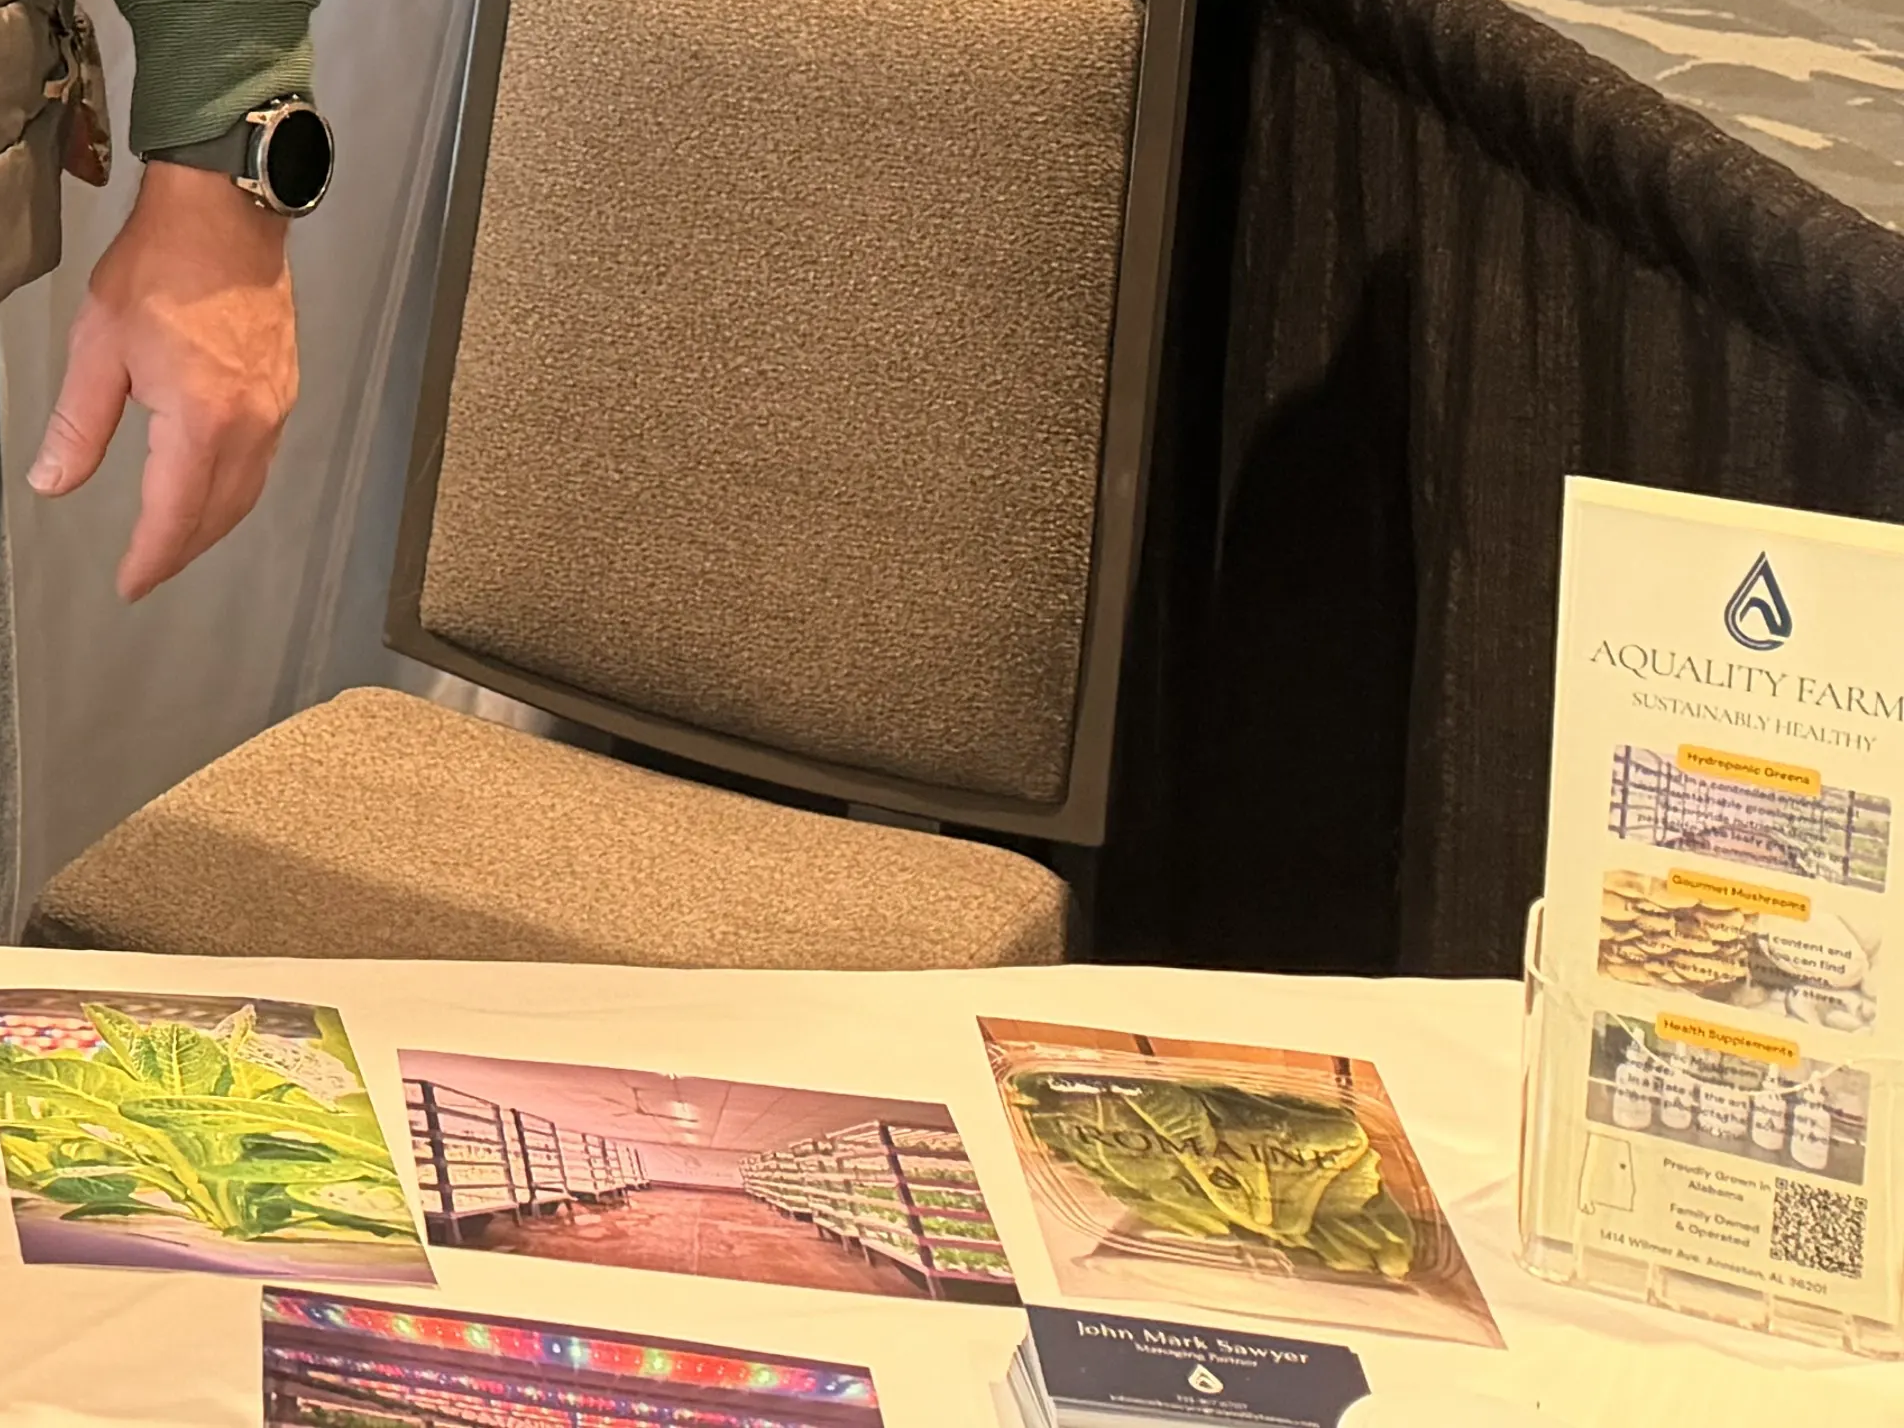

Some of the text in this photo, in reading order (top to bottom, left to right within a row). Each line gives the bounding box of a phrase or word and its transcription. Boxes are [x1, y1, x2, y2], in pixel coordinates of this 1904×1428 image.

[1590, 639, 1904, 722] AQUALITY FARM
[1632, 692, 1877, 752] SUSTAINABLY HEALTHY
[1687, 752, 1811, 785] Hydroponic Greens
[1671, 874, 1806, 913] Gourmet Mushrooms
[1664, 1018, 1795, 1058] Health Supplements
[1663, 1157, 1771, 1193] Proudly Grown in
[1688, 1180, 1744, 1201] Alabama
[1670, 1203, 1759, 1234] Family Owned
[1688, 1225, 1750, 1247] Operated
[1600, 1229, 1625, 1245] 1414
[1077, 1321, 1309, 1364] John Mark Sawyer
